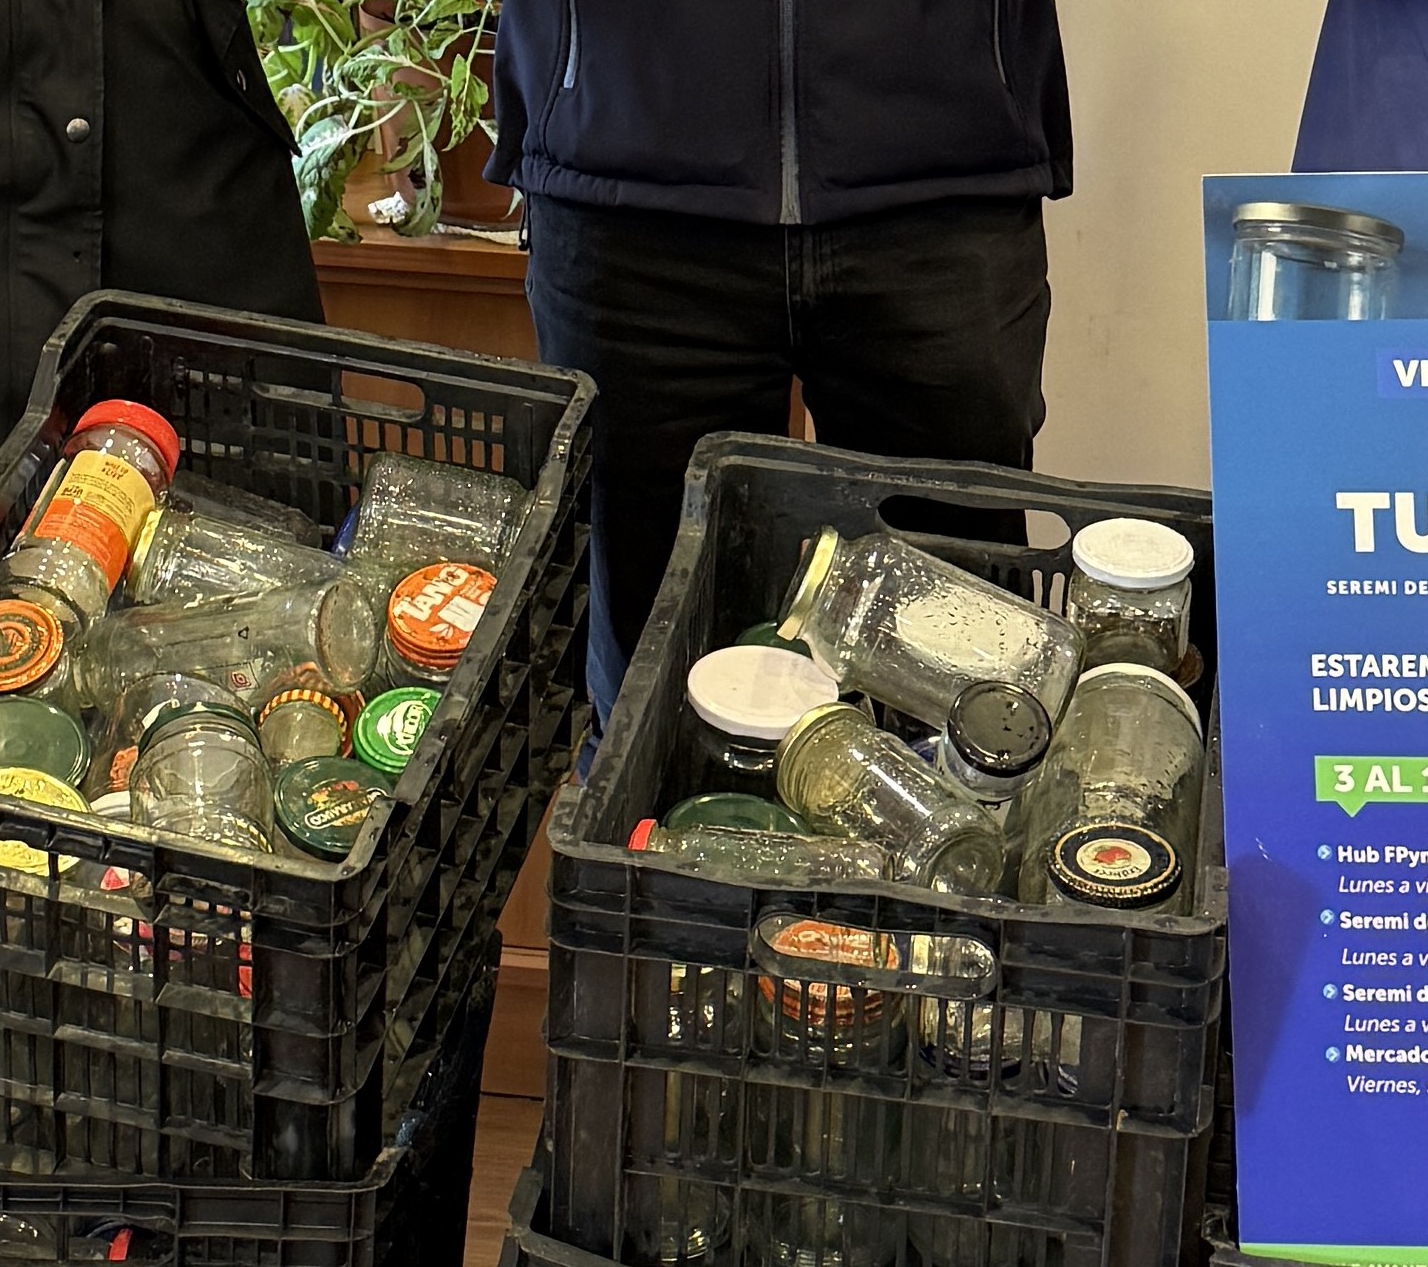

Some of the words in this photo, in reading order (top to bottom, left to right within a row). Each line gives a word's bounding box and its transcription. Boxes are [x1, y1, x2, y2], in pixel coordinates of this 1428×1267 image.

[392, 565, 471, 622] TANG
[1326, 580, 1397, 595] SEREMI
[1404, 580, 1428, 595] DE
[1333, 764, 1355, 793] 3
[1364, 765, 1413, 793] AL
[1337, 845, 1380, 863] Hub
[1338, 875, 1394, 894] Lunes
[1398, 880, 1410, 894] a
[1339, 911, 1409, 930] Seremi
[1341, 948, 1397, 966] Lunes
[1401, 953, 1414, 966] a
[1342, 983, 1412, 1002] Seremi
[1344, 1014, 1400, 1033] Lunes
[1404, 1019, 1416, 1033] a
[1347, 1075, 1421, 1096] Viernes,
